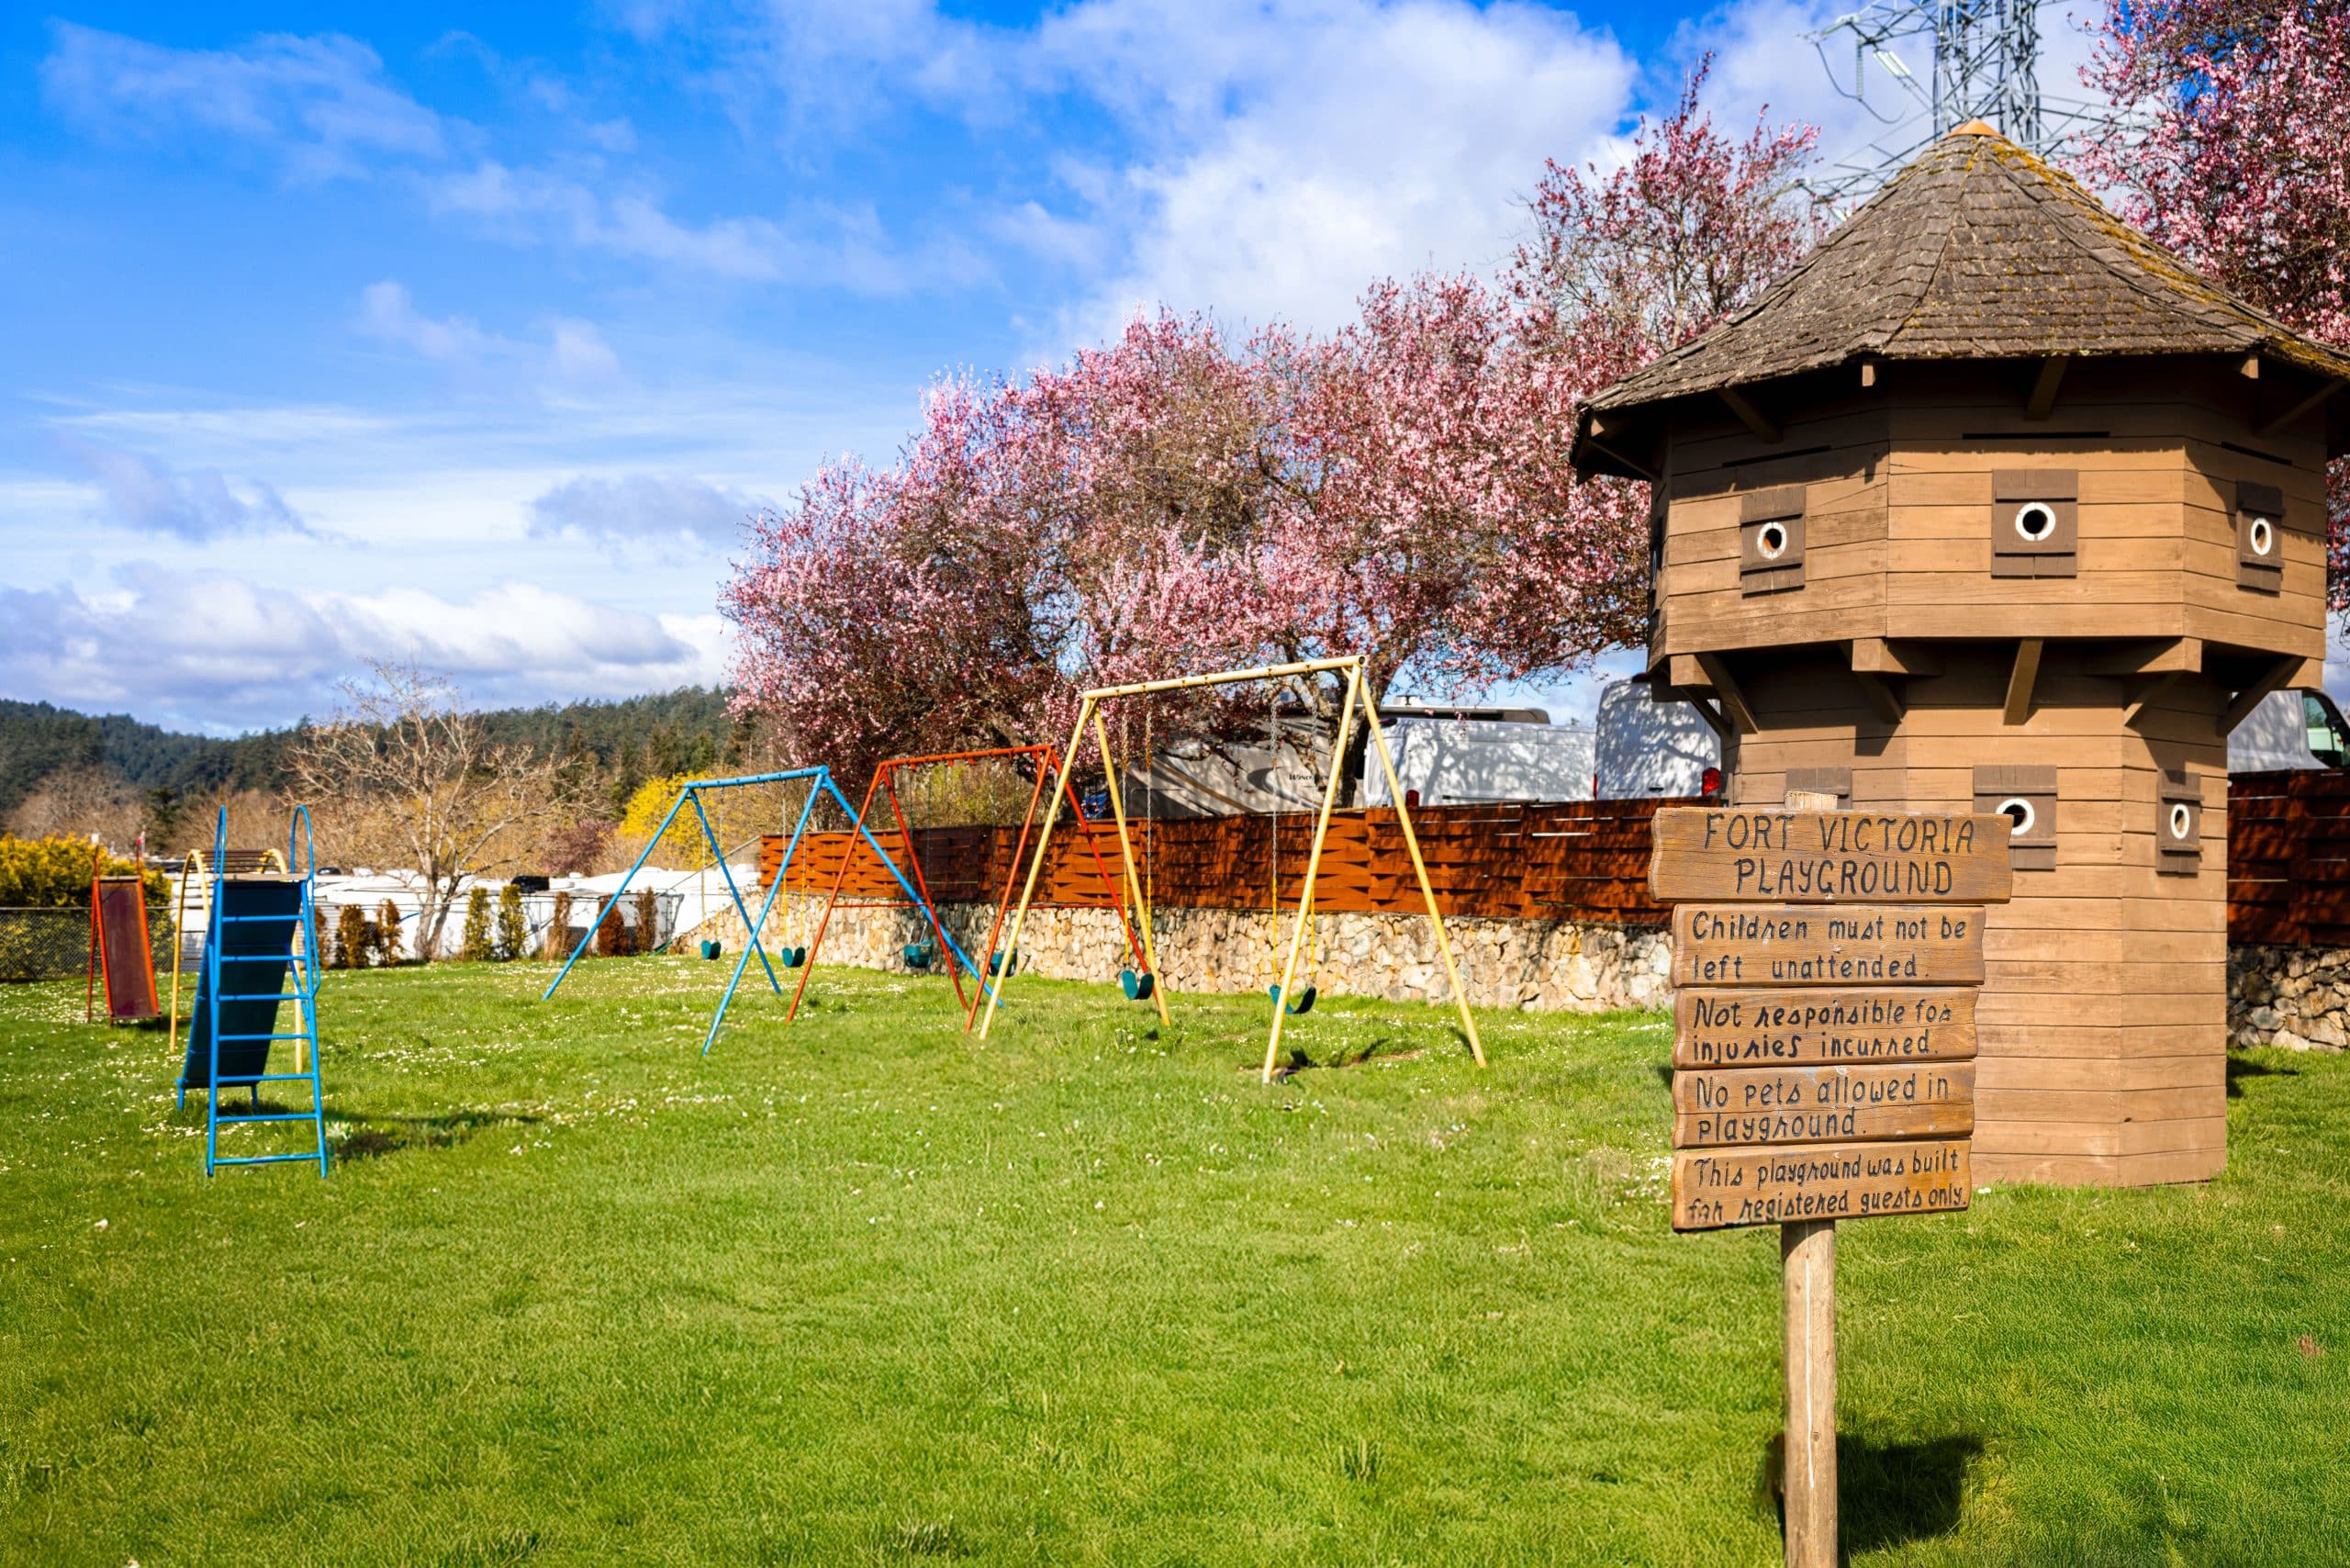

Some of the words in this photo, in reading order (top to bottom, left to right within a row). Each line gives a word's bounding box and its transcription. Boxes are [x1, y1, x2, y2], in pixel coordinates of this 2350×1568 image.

[1704, 812, 1796, 851] FORT
[1818, 816, 1975, 854] VICTORIA
[1734, 857, 1953, 895] PLAYGROUND
[1693, 910, 1808, 940] Children
[1829, 913, 1885, 940] must
[1897, 917, 1927, 940] not
[1942, 914, 1967, 939] be
[1694, 954, 1743, 981] left
[1772, 954, 1930, 980] unattended.
[1694, 997, 1742, 1030] Not
[1753, 998, 1906, 1029] responsible
[1821, 1028, 1940, 1058] incurred.
[1696, 1076, 1729, 1108] No
[1745, 1080, 1802, 1108] pets
[1817, 1072, 1917, 1103] allowed
[1928, 1072, 1950, 1102] in
[1697, 1105, 1867, 1144] playground.
[1694, 1158, 1743, 1188] This
[1757, 1153, 1863, 1192] playground
[1867, 1156, 1905, 1178] was
[1912, 1148, 1959, 1176] built
[1688, 1197, 1722, 1224] for
[1740, 1189, 1849, 1223] registered
[1861, 1186, 1922, 1215] guests
[1928, 1183, 1967, 1208] only.
